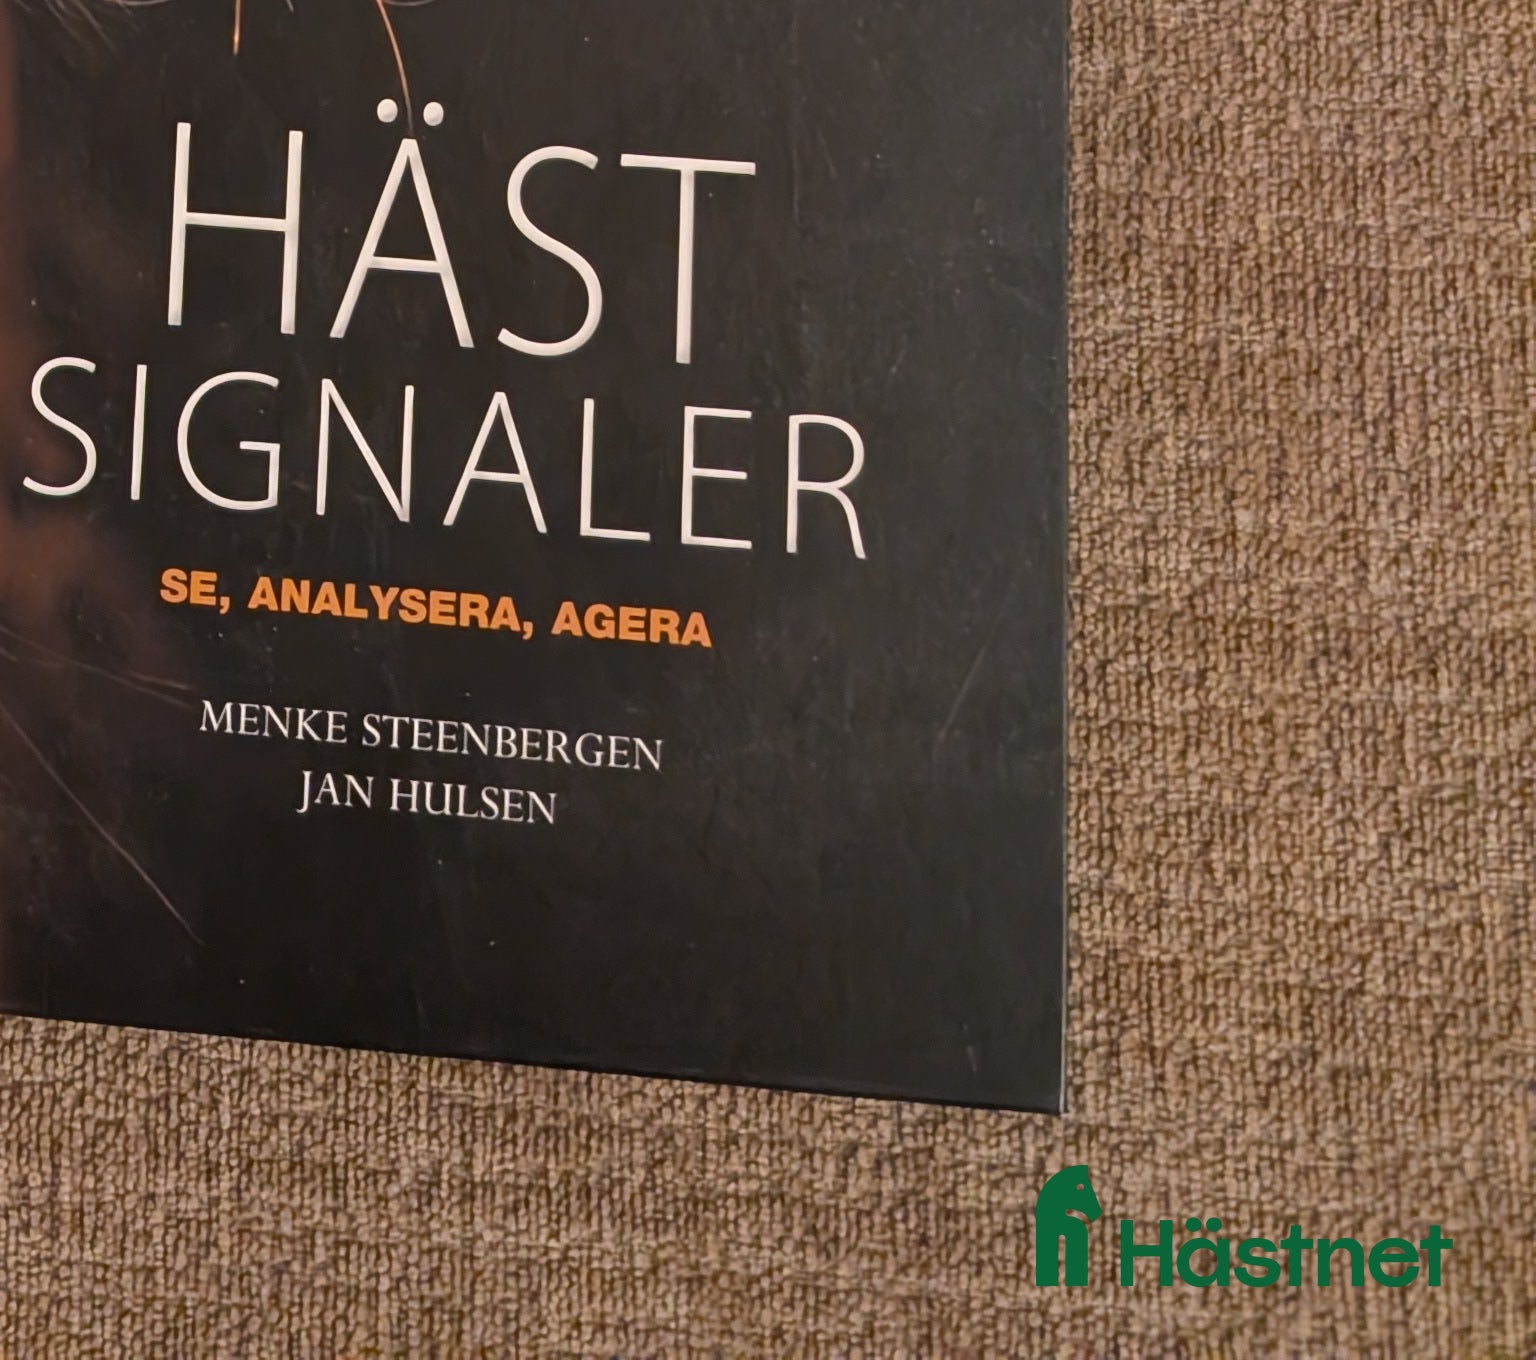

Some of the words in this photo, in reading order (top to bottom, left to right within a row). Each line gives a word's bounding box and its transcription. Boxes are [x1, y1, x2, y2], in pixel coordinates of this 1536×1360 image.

[167, 97, 757, 364] HÄST
[22, 356, 868, 560] SIGNALER
[159, 567, 232, 615] SE,
[248, 576, 535, 640] ANALYSERA,
[551, 600, 713, 649] AGERA
[199, 698, 349, 745] MENKE
[361, 713, 664, 772] STEENBERGEN
[296, 769, 375, 814] JAN
[389, 778, 558, 825] HULSEN
